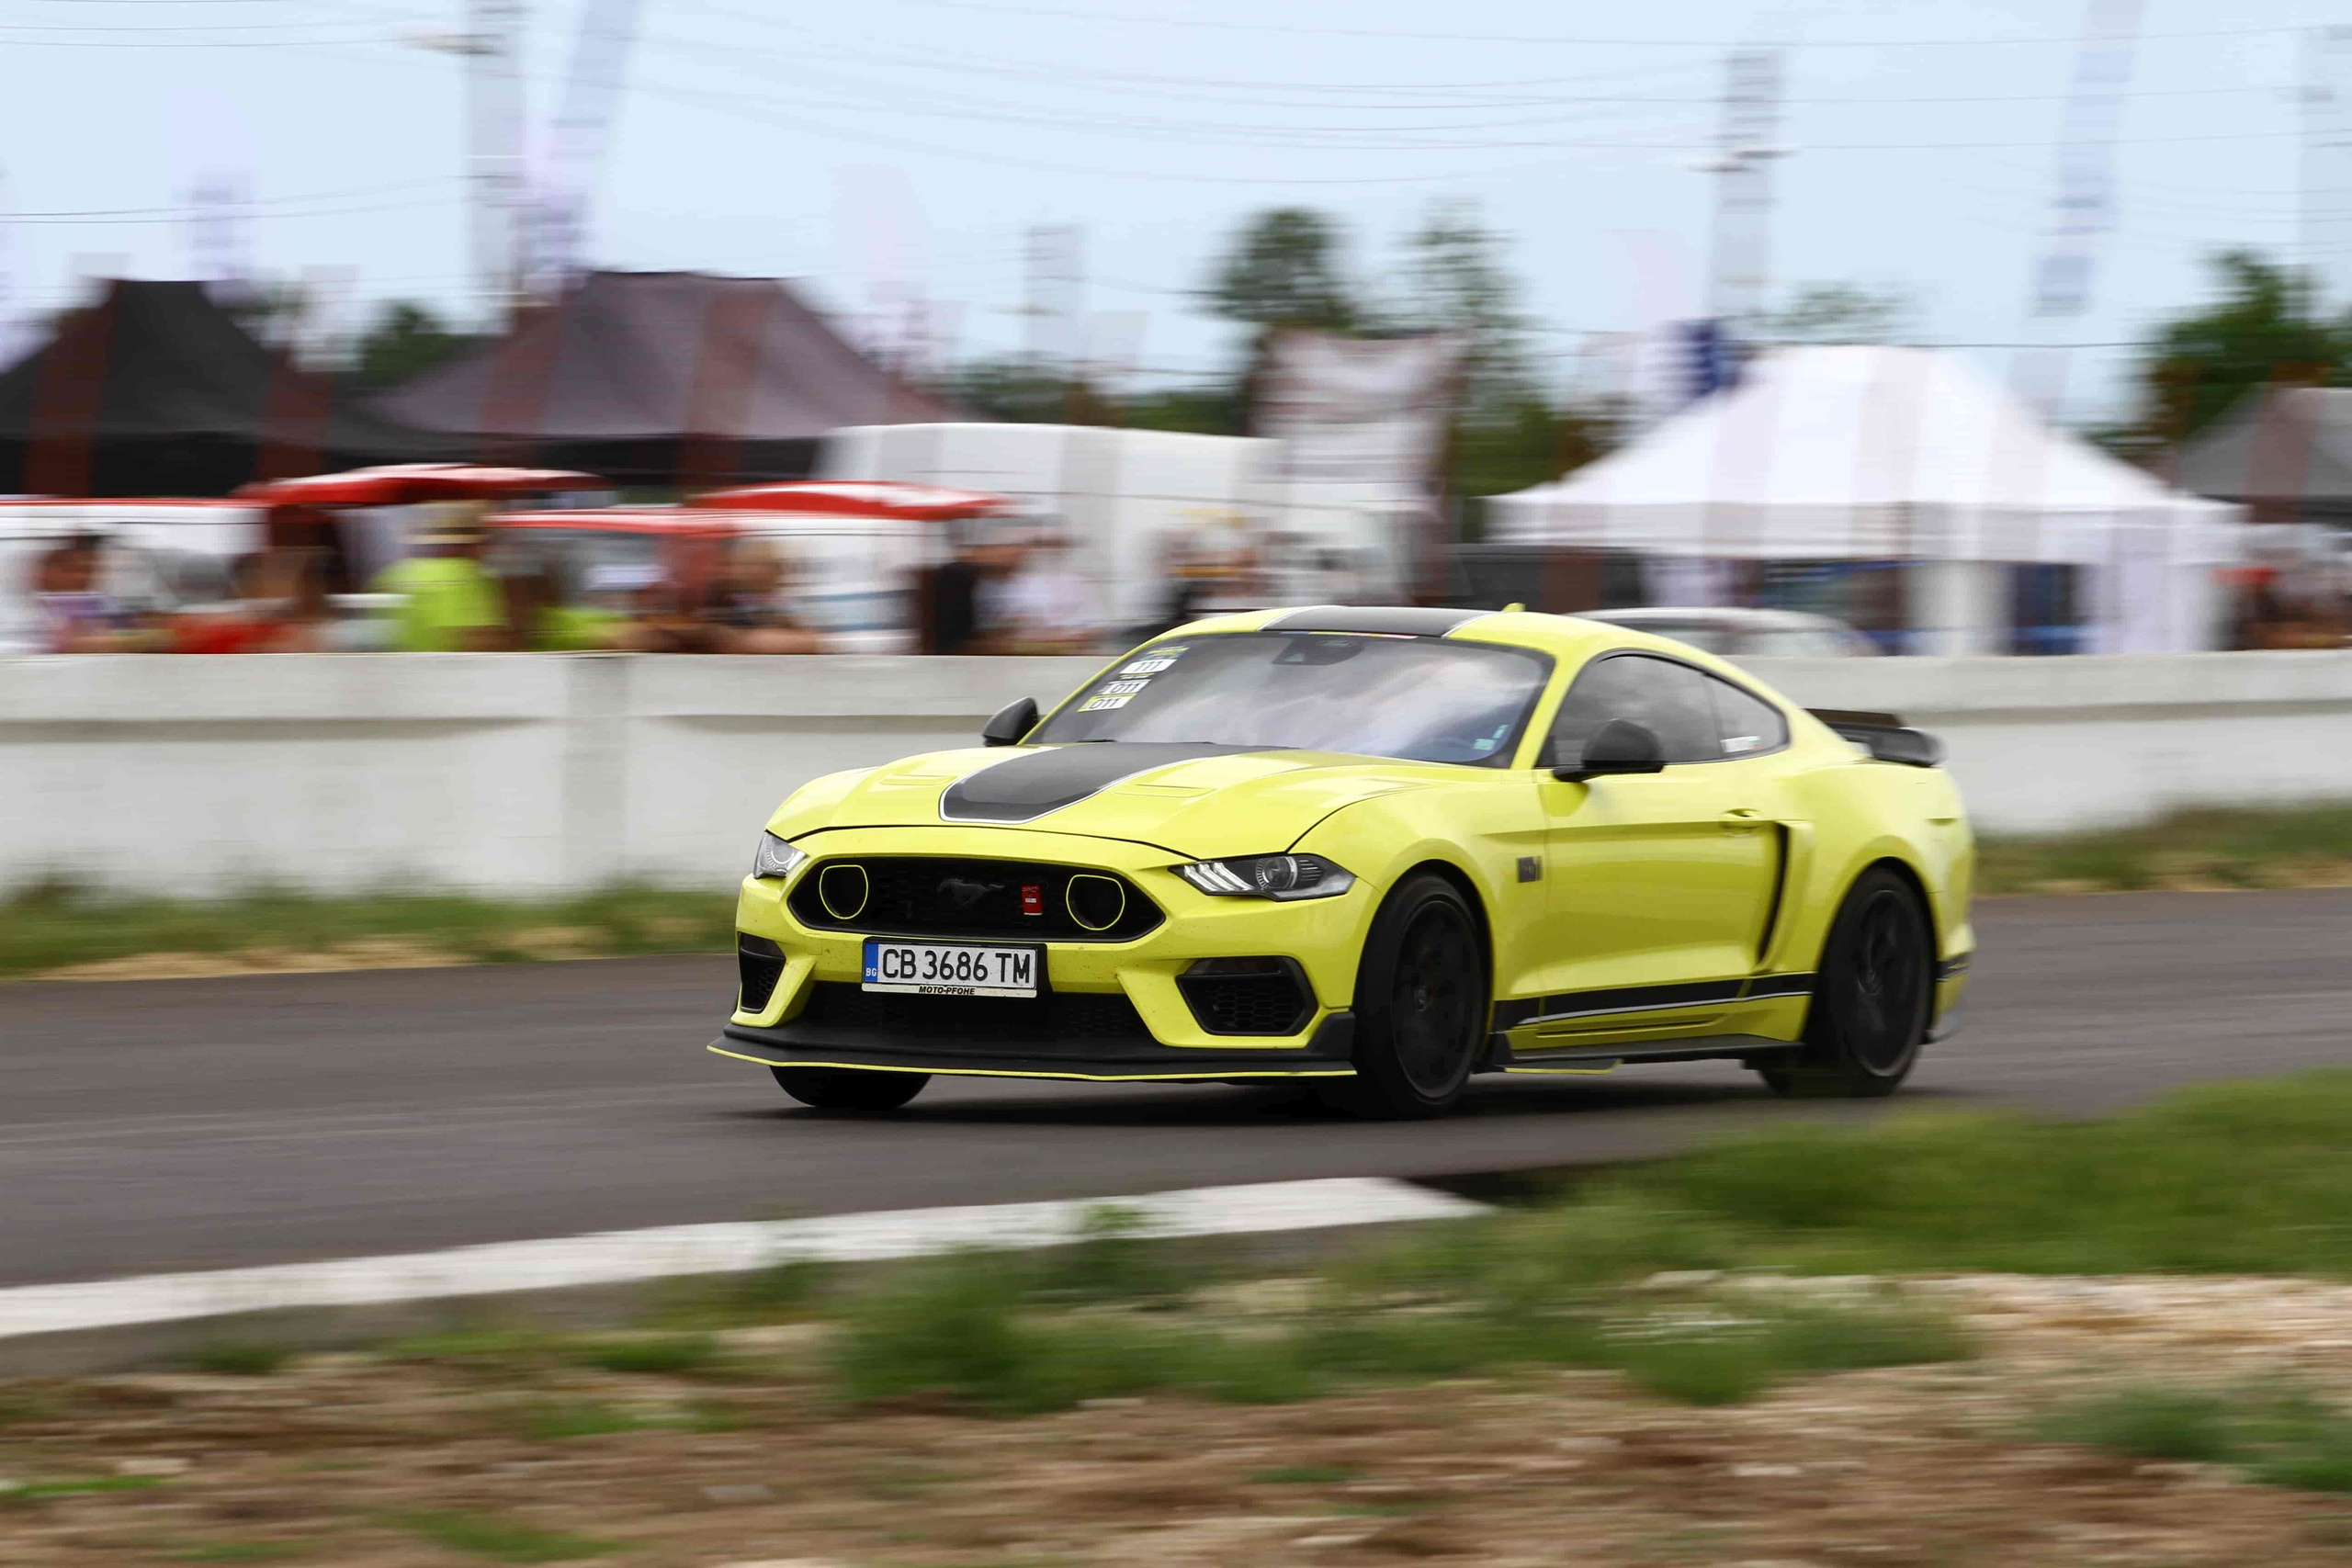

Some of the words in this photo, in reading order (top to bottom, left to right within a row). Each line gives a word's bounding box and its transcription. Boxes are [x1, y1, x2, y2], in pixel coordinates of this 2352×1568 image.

[882, 948, 917, 978] CB
[922, 950, 989, 982] 3686
[995, 953, 1031, 984] TM
[865, 967, 877, 976] BG
[919, 986, 976, 995] MOTO-PFOHE
